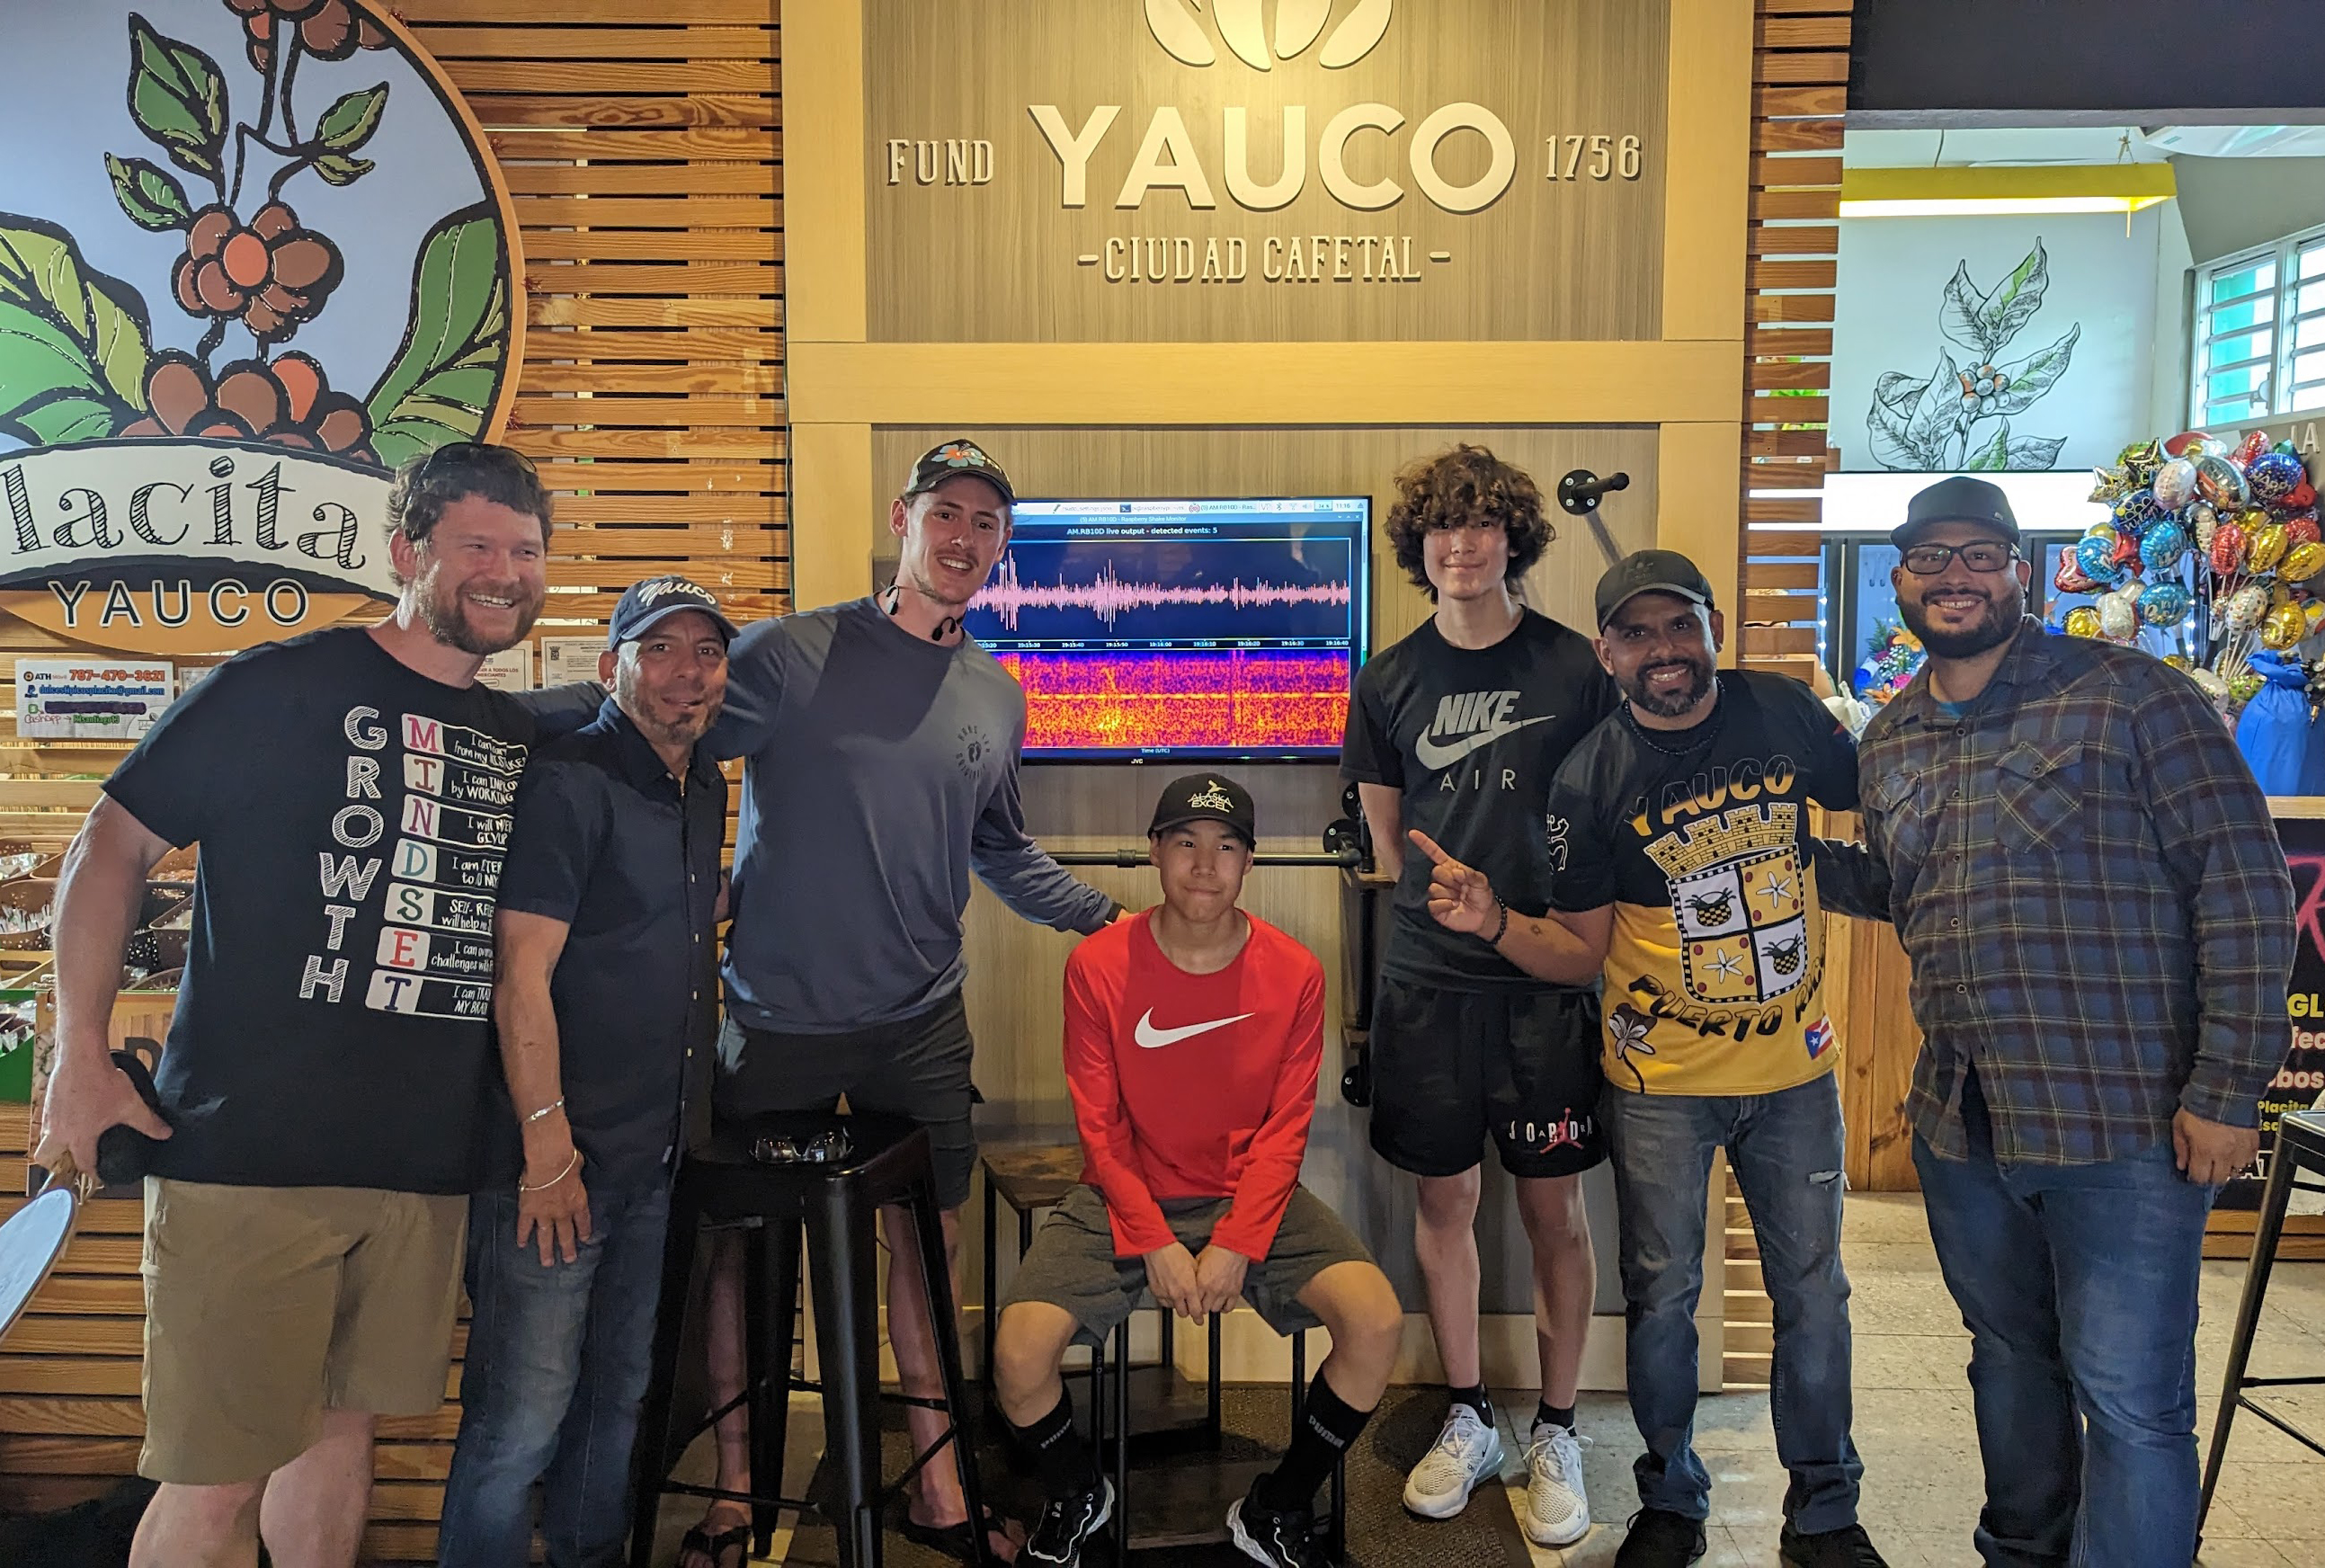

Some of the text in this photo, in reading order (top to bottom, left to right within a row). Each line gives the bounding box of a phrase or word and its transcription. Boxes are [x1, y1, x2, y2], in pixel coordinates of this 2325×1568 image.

[887, 138, 995, 185] FUND
[1028, 102, 1517, 214] YAUCO
[1546, 133, 1644, 182] 1756
[1120, 527, 1145, 535] output
[1151, 526, 1182, 534] detected
[48, 578, 310, 628] YAUCO
[1431, 690, 1522, 737] NIKE
[454, 740, 473, 758] from
[474, 751, 488, 764] my
[463, 771, 468, 783] I
[472, 775, 487, 787] can
[1439, 769, 1517, 792] AIR
[450, 780, 464, 798] by
[1624, 754, 1796, 837] YAUCO
[1187, 792, 1234, 809] ALASKA
[1191, 799, 1230, 813] EXCEL
[468, 815, 474, 829] I
[477, 820, 493, 831] will
[452, 856, 459, 869] I
[460, 861, 478, 870] am
[462, 872, 475, 884] to
[460, 916, 479, 930] help
[455, 940, 460, 954] I
[463, 945, 477, 956] can
[431, 952, 477, 973] challenges
[461, 989, 475, 1000] can
[454, 1000, 469, 1014] MY
[1628, 974, 1783, 1043] PUERTO
